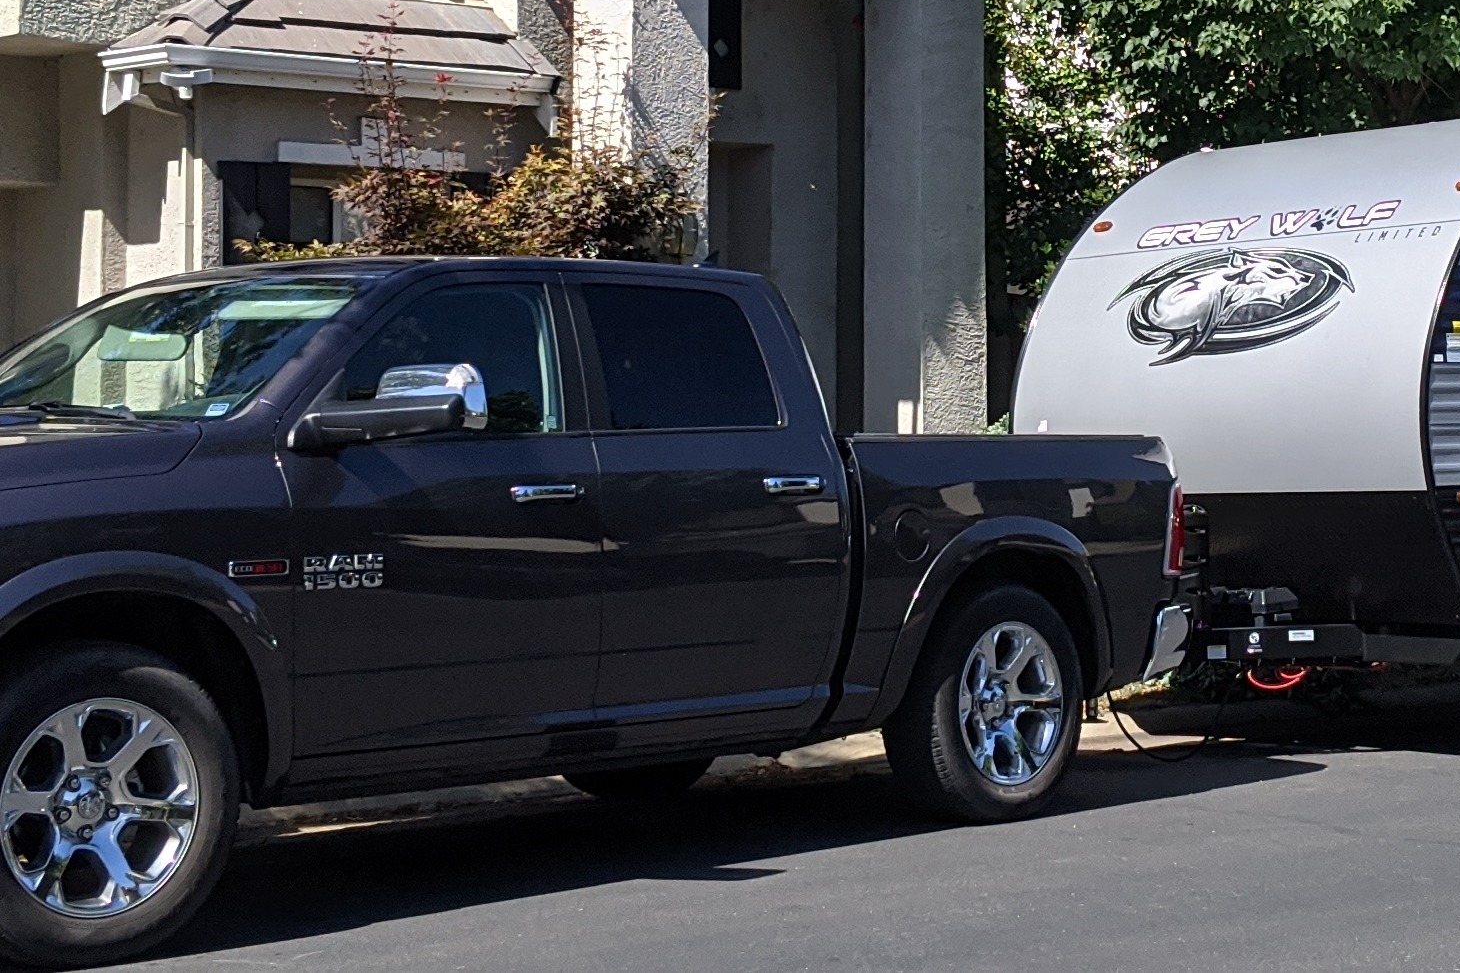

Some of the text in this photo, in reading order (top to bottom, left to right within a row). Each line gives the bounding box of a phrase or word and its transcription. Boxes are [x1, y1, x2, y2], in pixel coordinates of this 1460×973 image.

[1137, 214, 1261, 249] GREY
[1354, 225, 1442, 243] LIMITED
[303, 553, 384, 572] RAM
[303, 572, 384, 590] 1500
